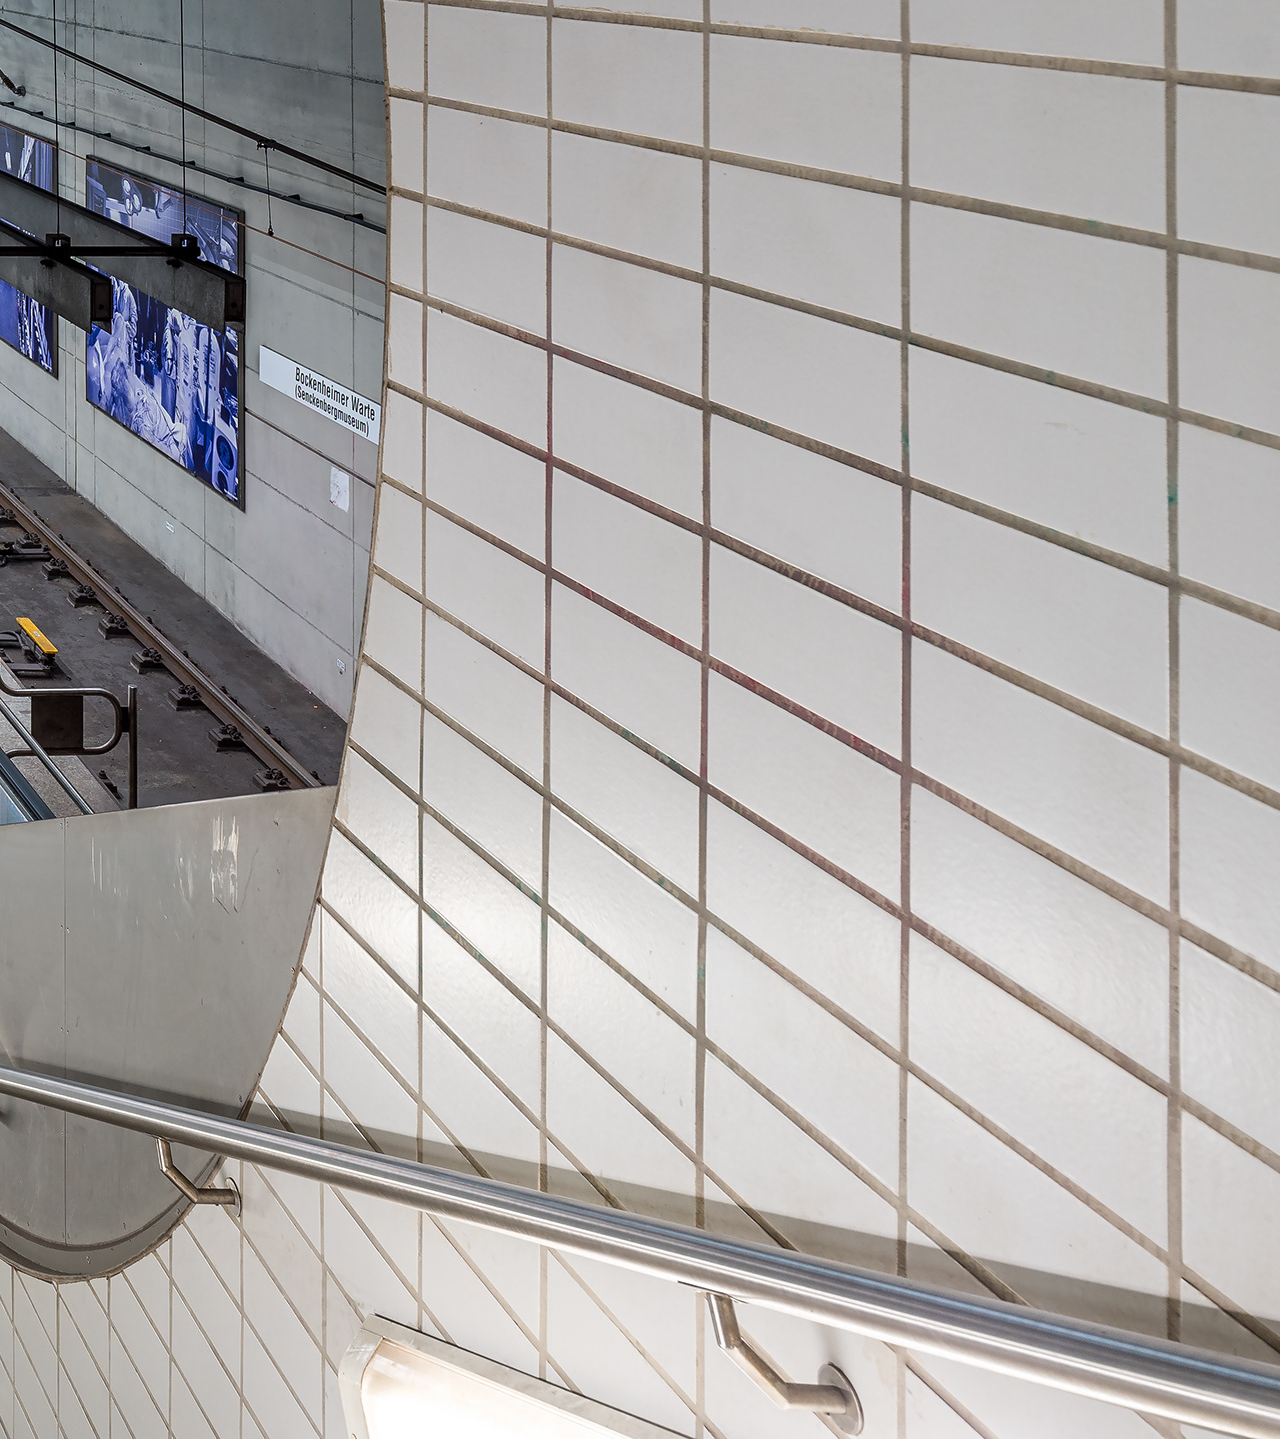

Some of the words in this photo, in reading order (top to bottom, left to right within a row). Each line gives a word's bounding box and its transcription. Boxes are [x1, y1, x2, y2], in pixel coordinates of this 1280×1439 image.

[294, 384, 370, 437] (Senckenbergmuseum)
[295, 366, 349, 408] Bockenheimer
[351, 394, 375, 421] Warte
